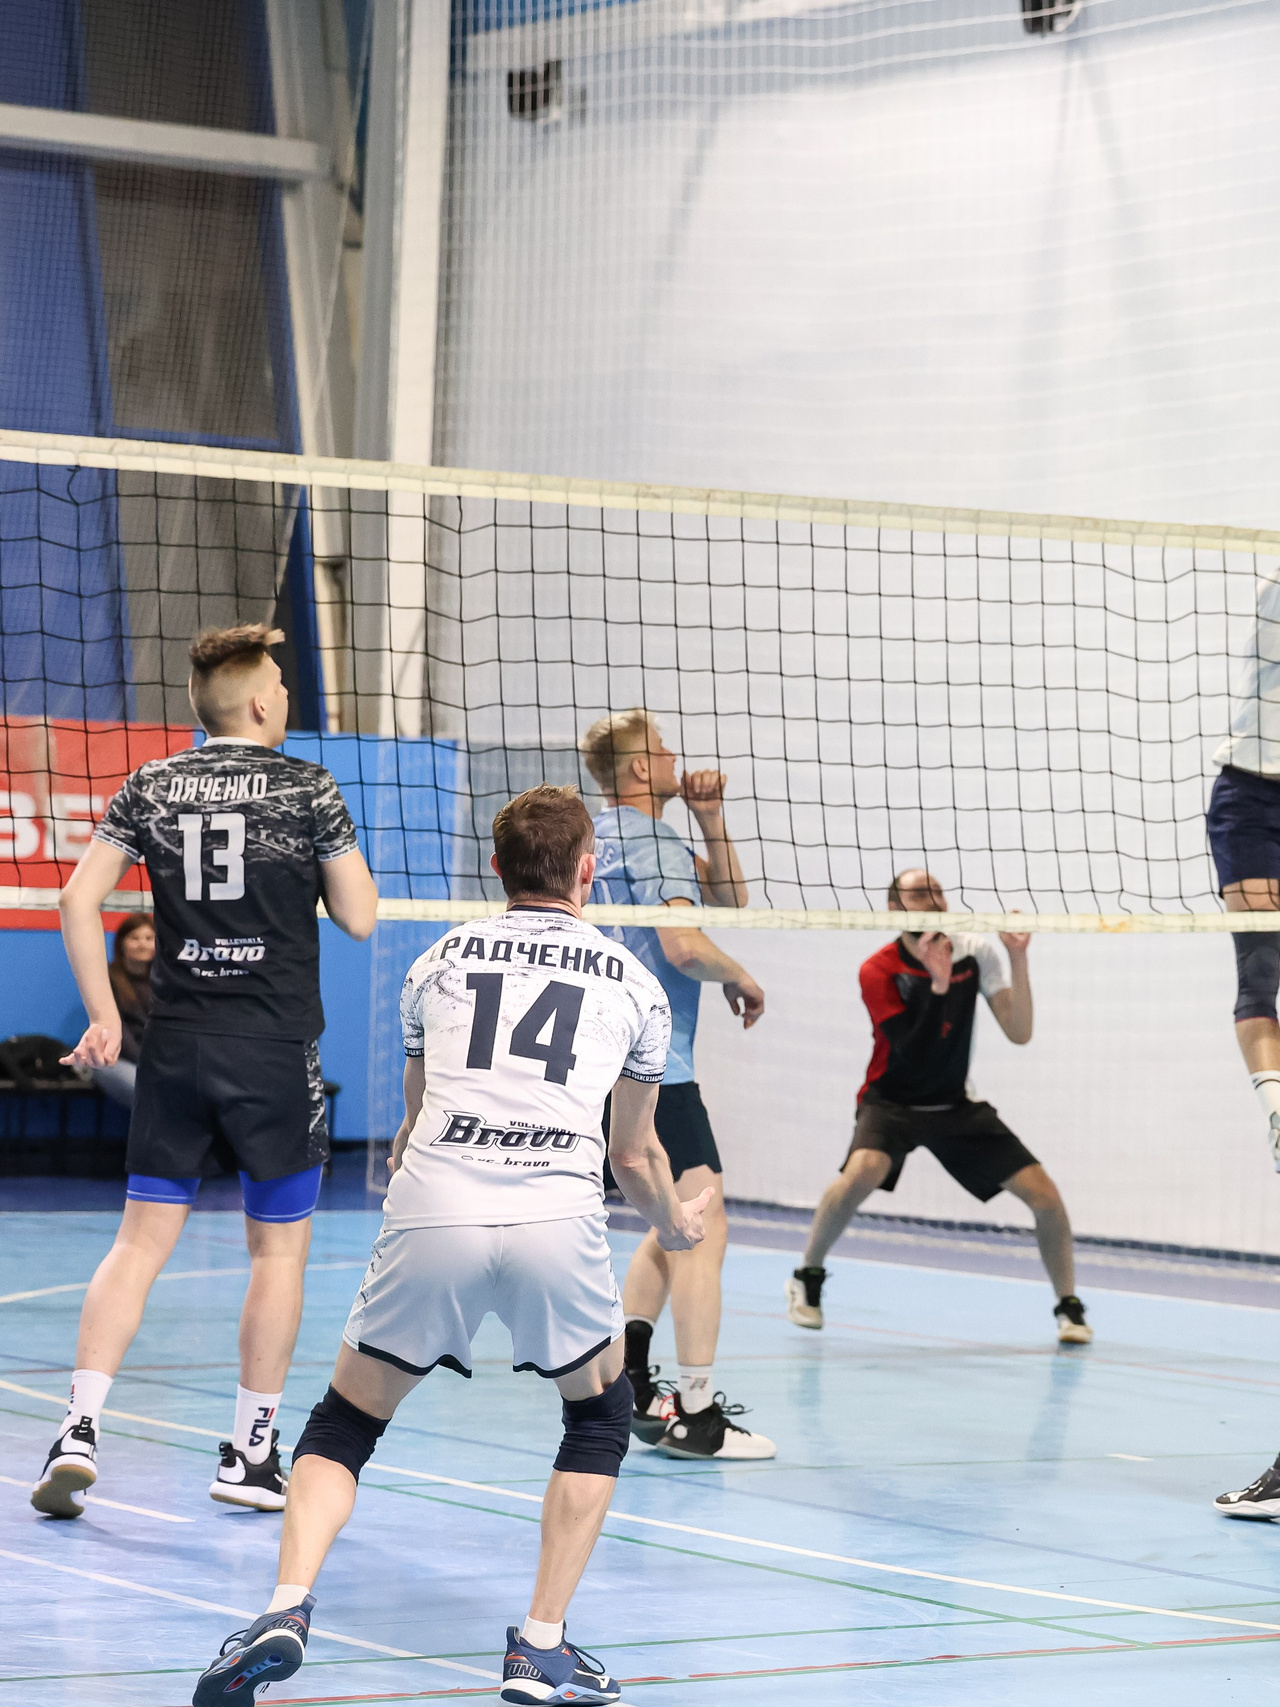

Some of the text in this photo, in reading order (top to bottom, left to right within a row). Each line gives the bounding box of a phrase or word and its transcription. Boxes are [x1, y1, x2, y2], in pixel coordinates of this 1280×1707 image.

[167, 773, 268, 804] ДЯЧЕНКО
[177, 812, 246, 901] 13
[177, 938, 266, 962] Bravo
[440, 936, 625, 983] РАДЧЕНКО
[465, 972, 586, 1087] 14
[436, 1113, 578, 1150] Bravo
[248, 1406, 276, 1447] FILA
